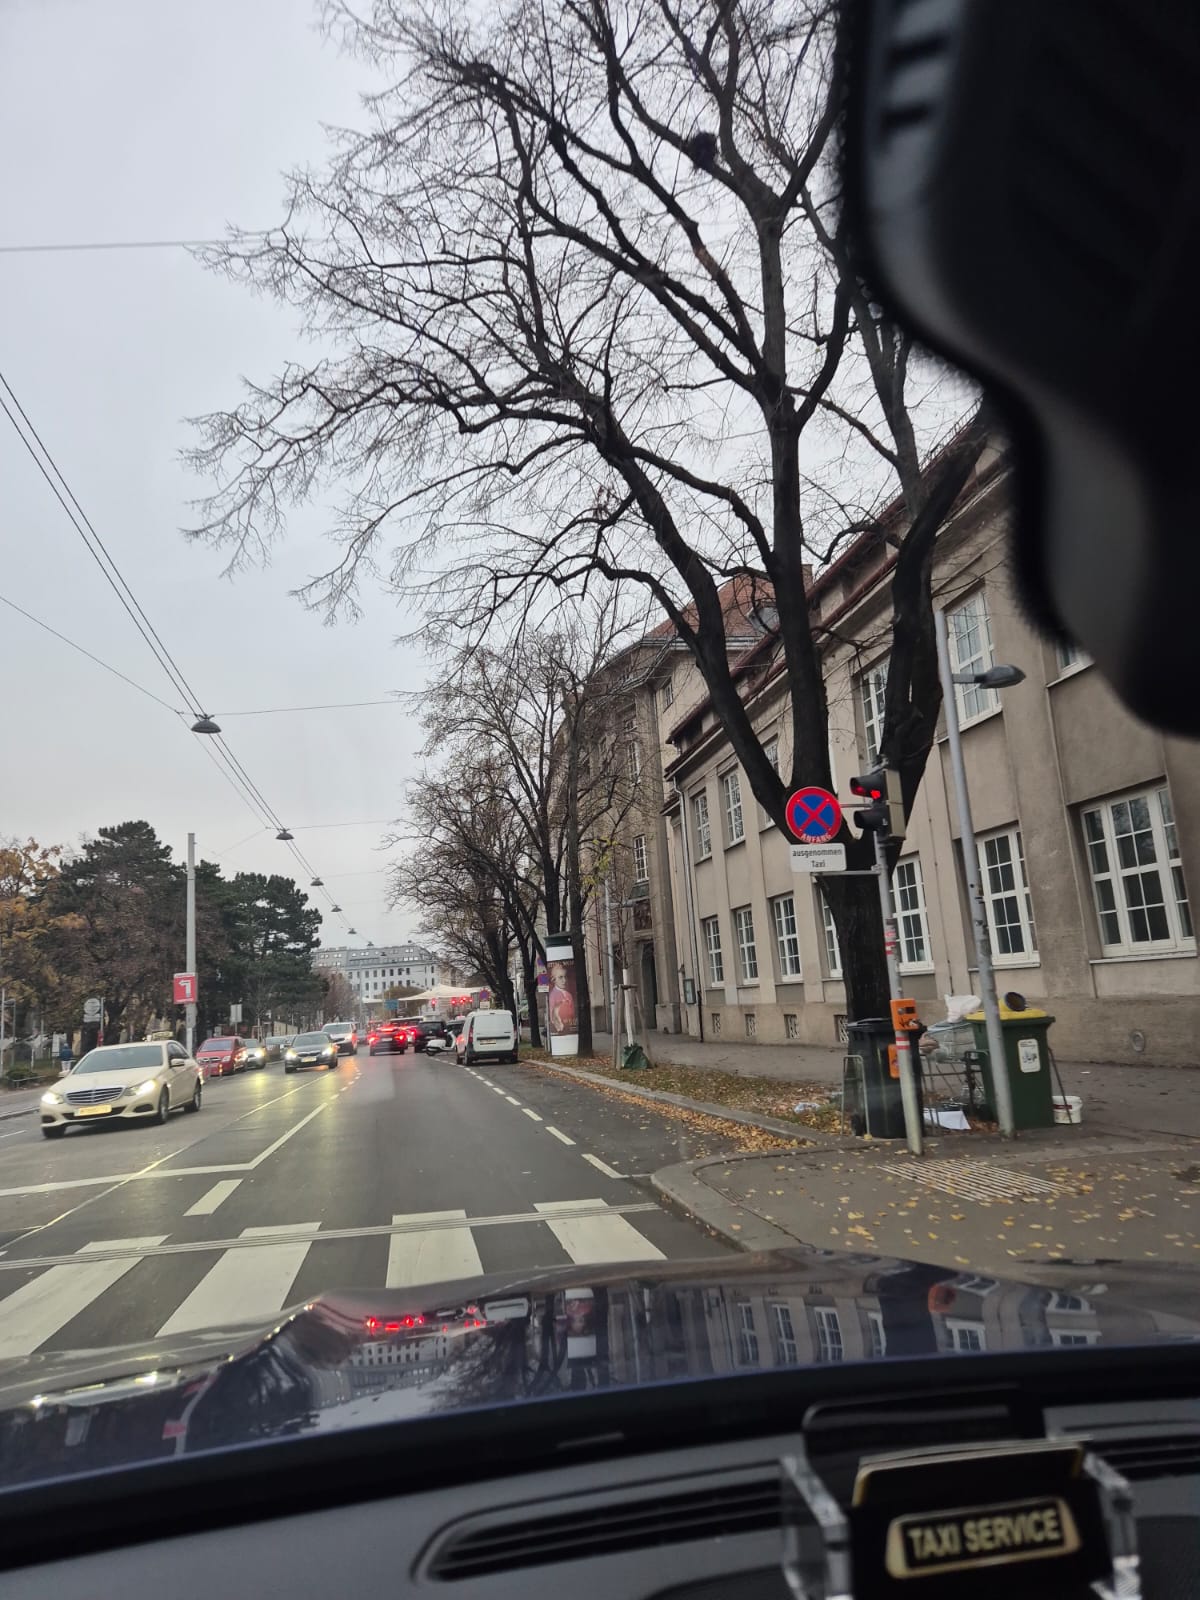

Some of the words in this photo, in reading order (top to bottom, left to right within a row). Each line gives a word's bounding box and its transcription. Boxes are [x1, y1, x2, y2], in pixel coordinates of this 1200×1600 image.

[800, 833, 832, 844] ANFANG
[792, 849, 842, 858] ausgenommen
[811, 860, 826, 868] Taxi
[908, 1523, 962, 1560] TAXI
[963, 1508, 1061, 1553] SERVICE
